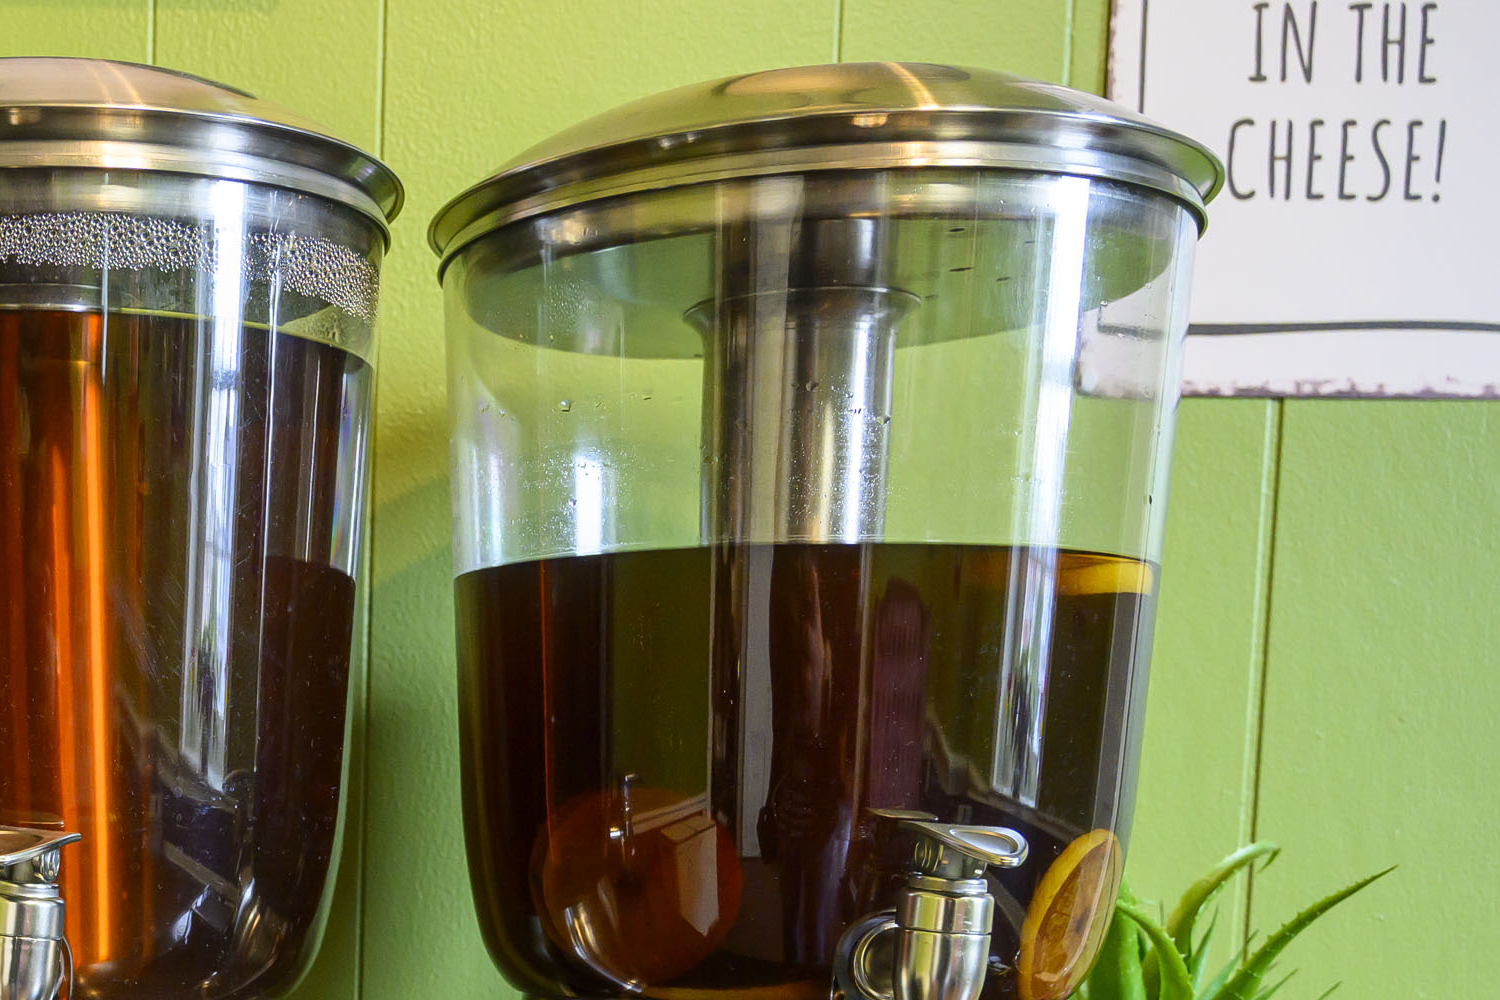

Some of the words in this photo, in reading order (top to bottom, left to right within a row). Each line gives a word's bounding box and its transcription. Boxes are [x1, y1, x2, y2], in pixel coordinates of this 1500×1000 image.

[1250, 1, 1317, 82] IN
[1350, 4, 1436, 84] THE
[1228, 119, 1445, 201] CHEESE!
